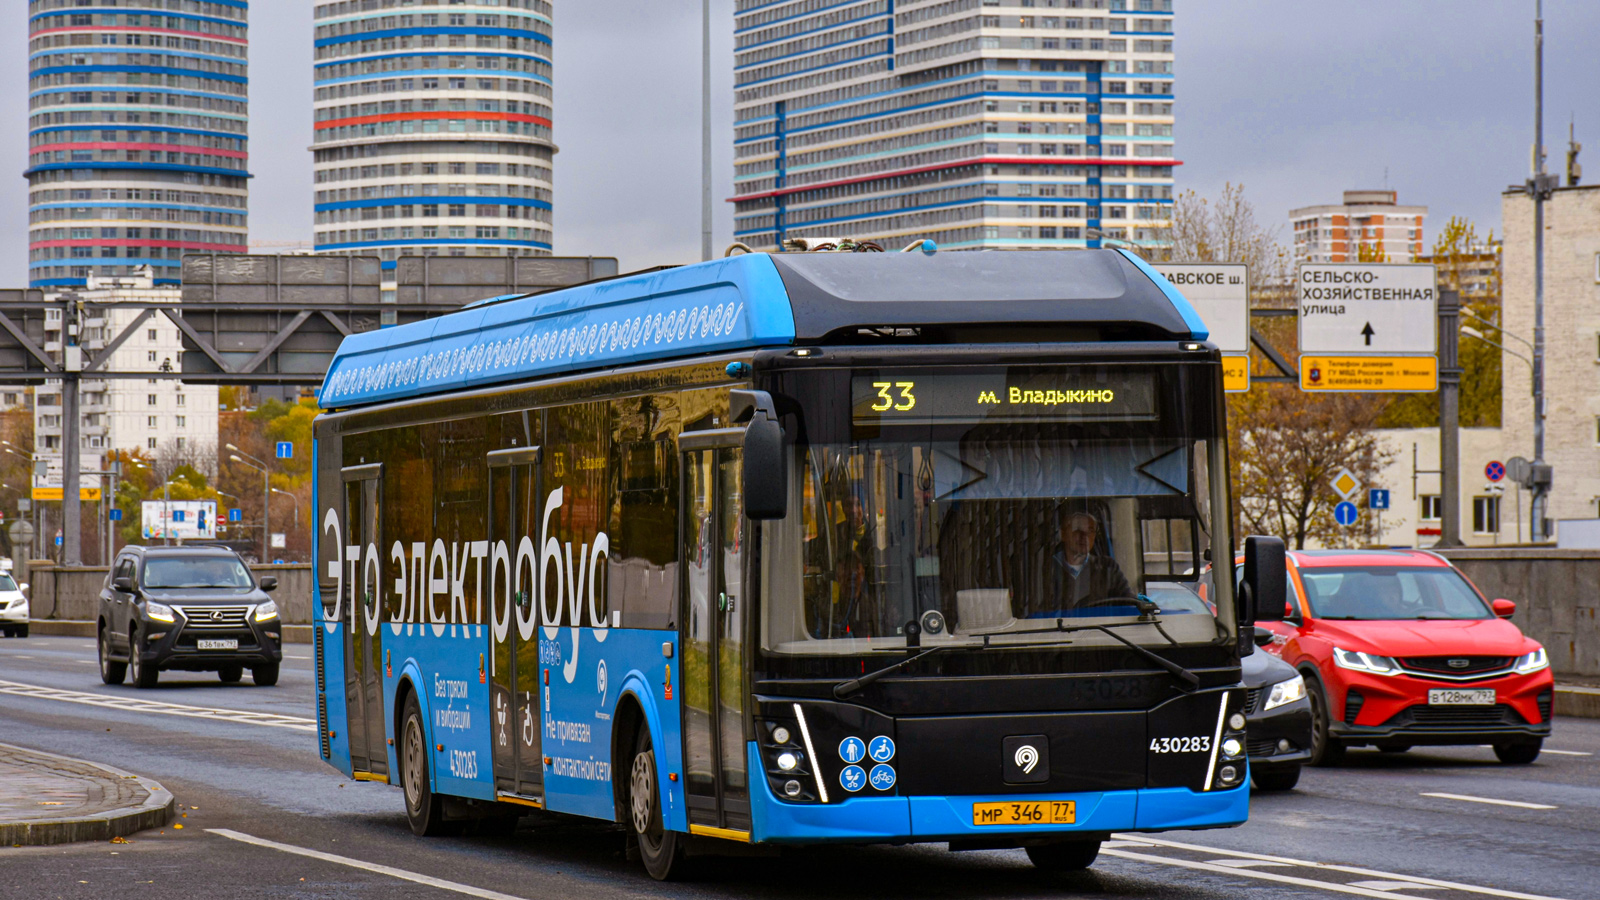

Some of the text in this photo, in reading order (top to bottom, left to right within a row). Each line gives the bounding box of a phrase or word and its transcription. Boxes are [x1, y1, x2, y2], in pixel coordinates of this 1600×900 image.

[1229, 275, 1245, 285] ш.
[1302, 271, 1379, 284] СЕЛЬСКО-
[1302, 286, 1433, 300] ХОЗЯЙСТВЕННАЯ
[1302, 305, 1346, 317] улица
[1237, 369, 1244, 377] 2
[1328, 360, 1360, 368] Телефон
[871, 381, 1114, 411] 33 м. Владыкино
[323, 484, 621, 684] Это электробус.
[435, 672, 468, 704] Без тряски
[436, 703, 471, 734] и вибраций
[545, 712, 592, 747] Не привязан
[1150, 736, 1211, 754] 430283
[450, 749, 478, 779] 430283
[553, 755, 595, 781] контактной
[982, 803, 1070, 822] МР 346 77
